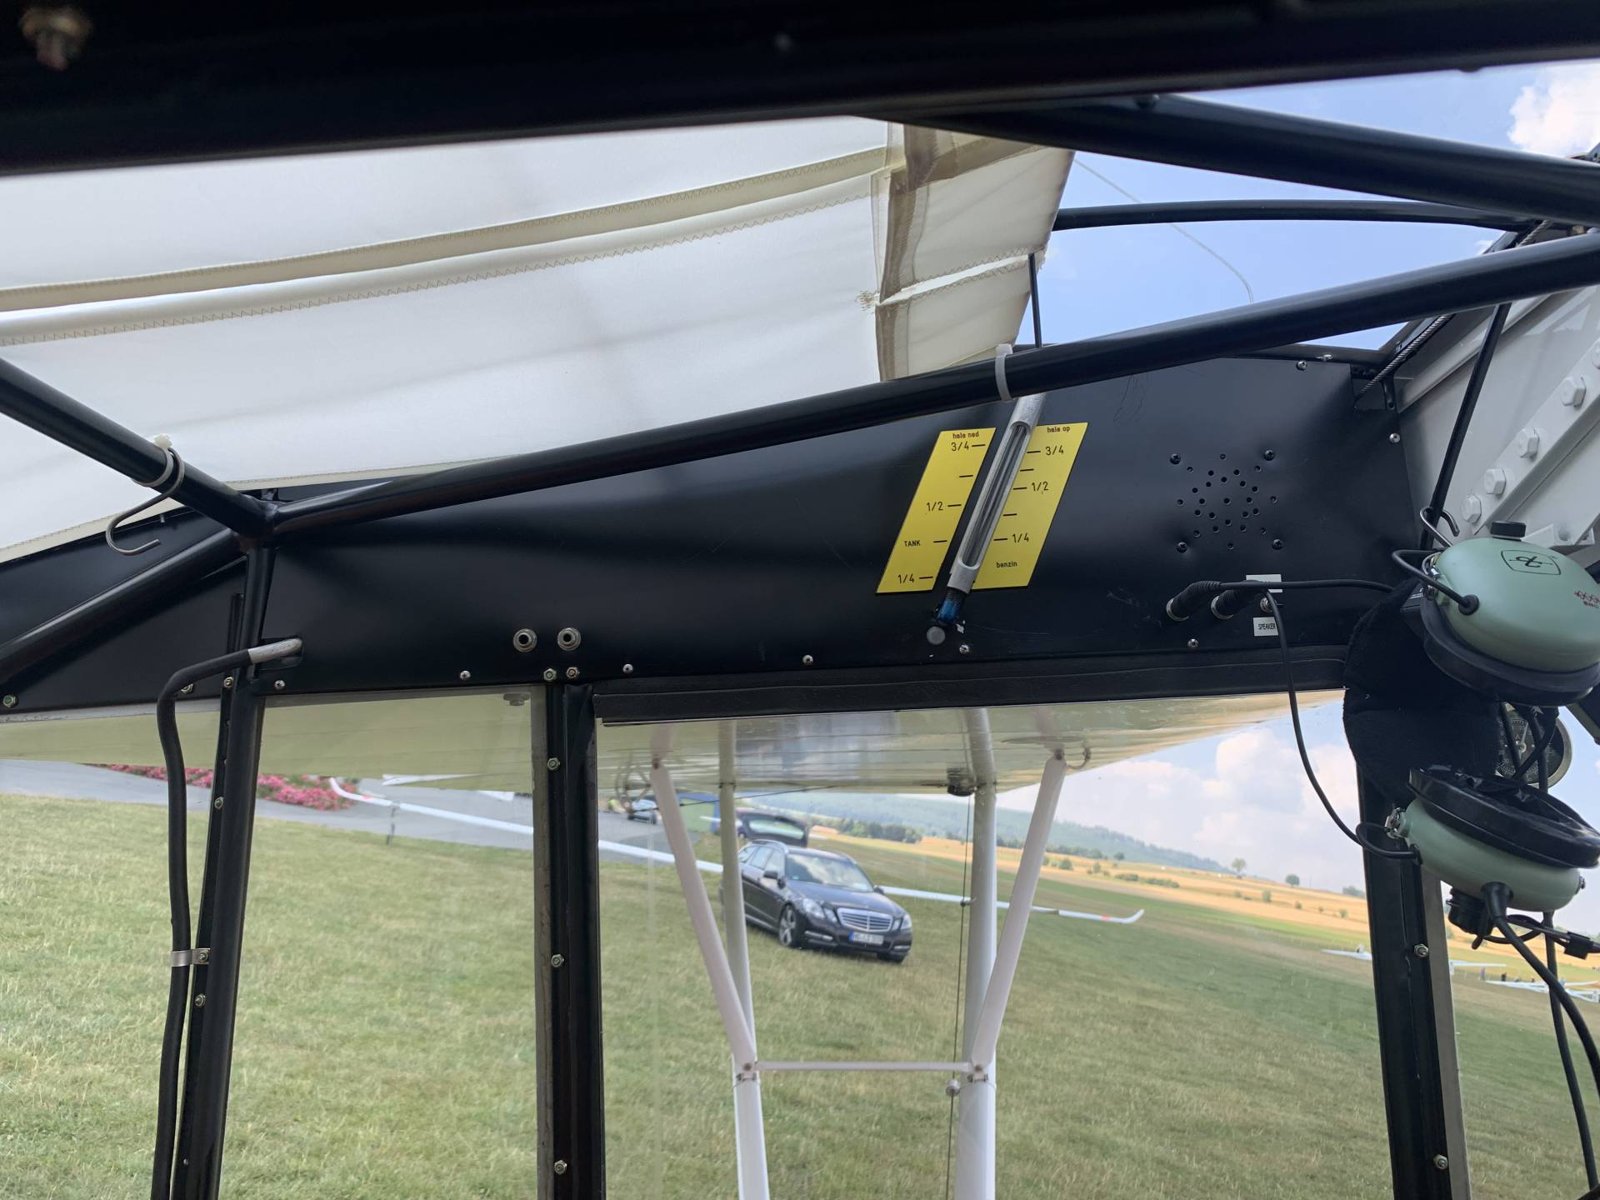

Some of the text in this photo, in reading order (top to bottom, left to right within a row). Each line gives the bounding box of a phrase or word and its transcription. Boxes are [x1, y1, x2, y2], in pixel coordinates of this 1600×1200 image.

[951, 441, 969, 452] 3/4
[1045, 445, 1064, 456] 3/4
[1031, 481, 1049, 492] 1/2
[926, 501, 944, 512] 1/2
[1012, 533, 1029, 543] 1/4
[897, 574, 915, 584] 1/4
